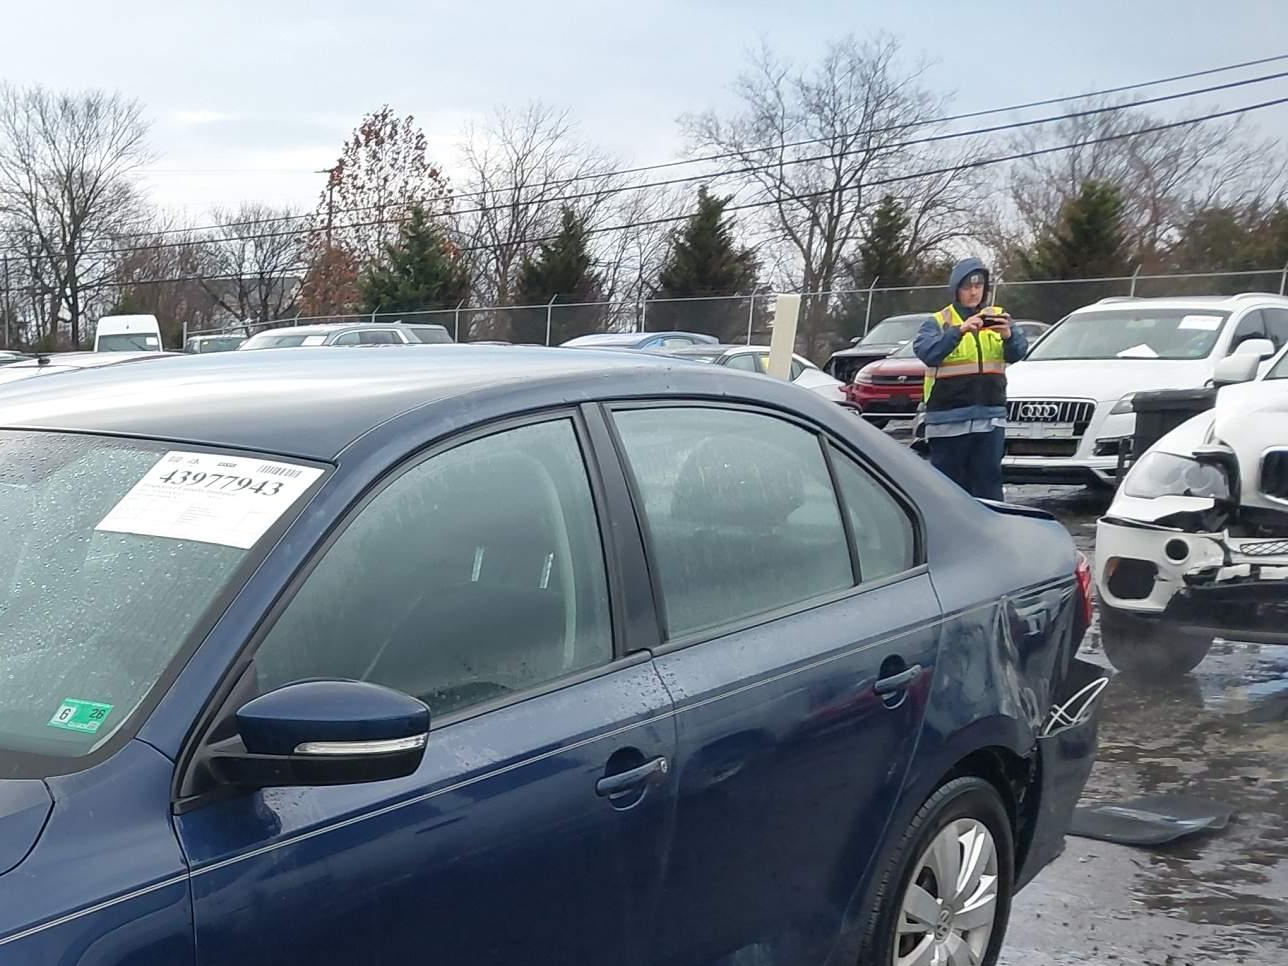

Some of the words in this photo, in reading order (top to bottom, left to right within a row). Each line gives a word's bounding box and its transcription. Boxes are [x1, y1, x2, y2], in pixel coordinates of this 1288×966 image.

[159, 468, 285, 496] 43977943
[59, 708, 72, 721] 6
[89, 708, 106, 720] 26
